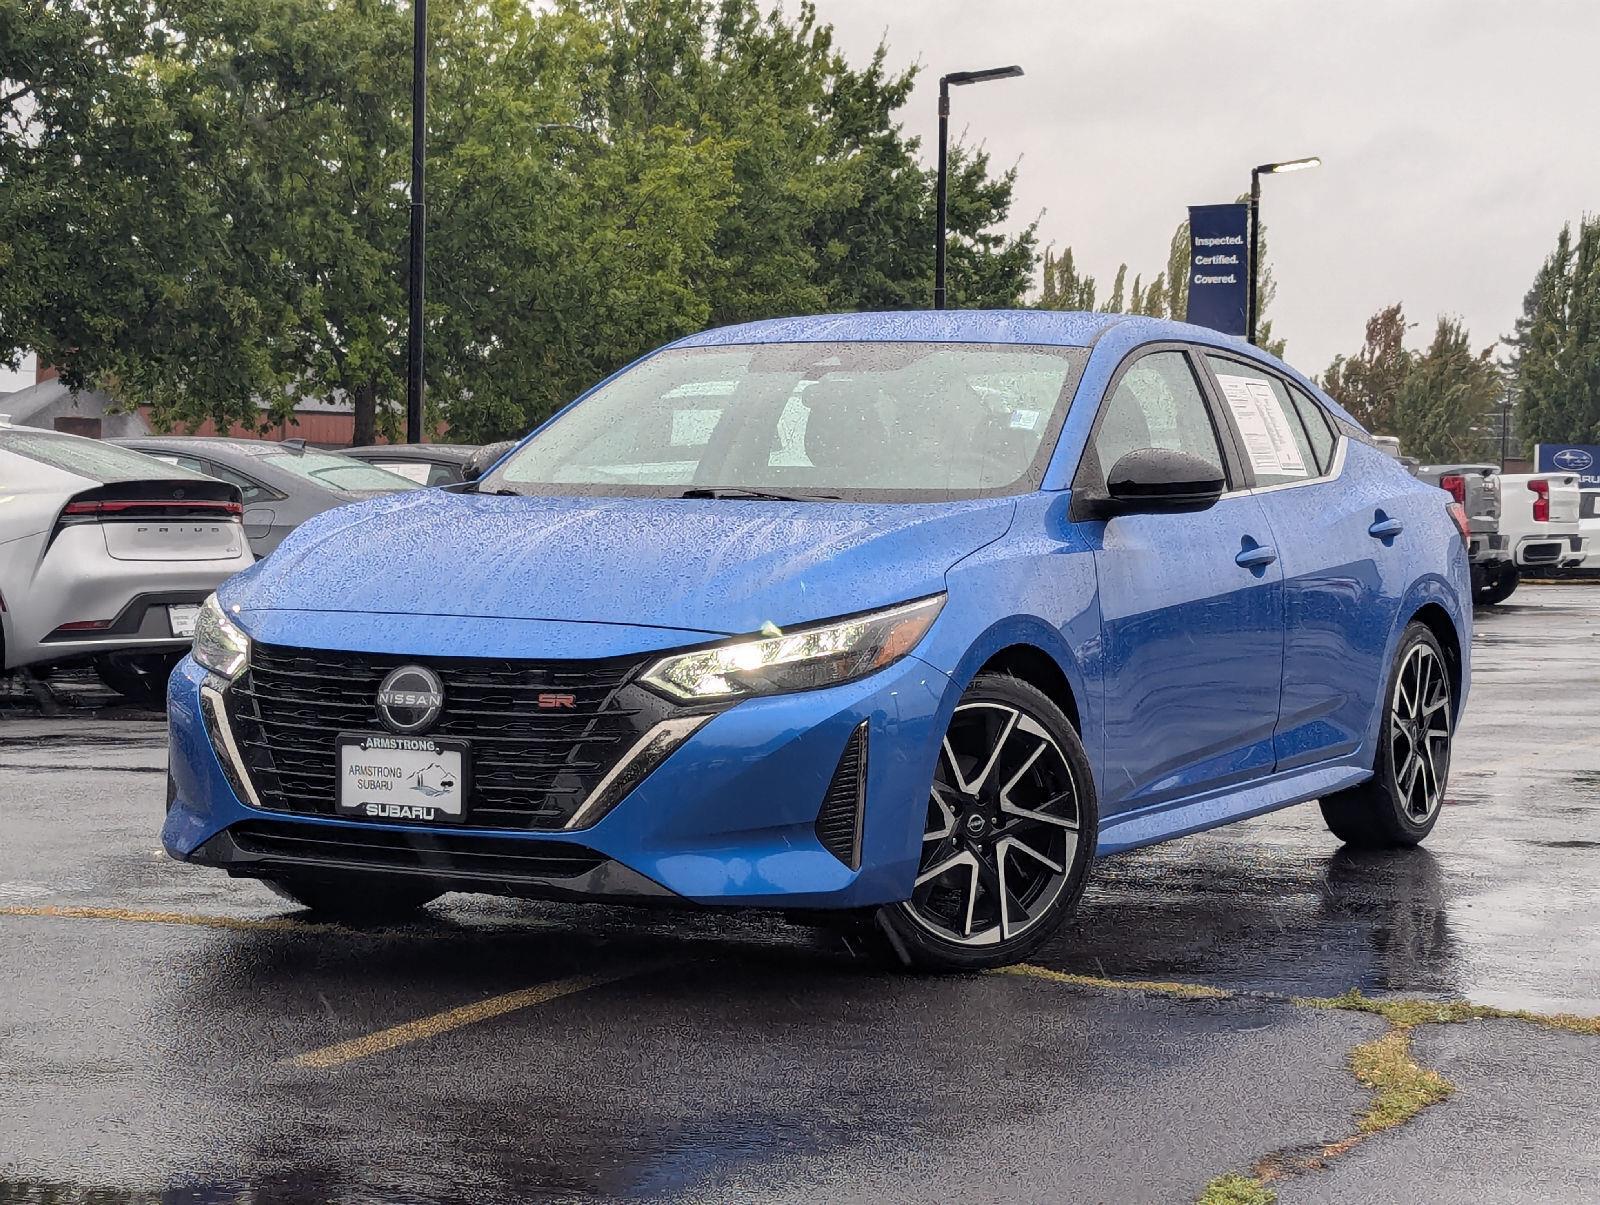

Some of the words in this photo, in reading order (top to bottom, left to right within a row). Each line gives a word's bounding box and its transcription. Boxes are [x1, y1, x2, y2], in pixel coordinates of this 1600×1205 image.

[1195, 235, 1244, 248] Inspected.
[1195, 255, 1239, 265] Certified.
[1194, 274, 1237, 284] Covered.
[379, 693, 440, 706] NISSAN
[538, 694, 577, 707] SR
[366, 737, 435, 751] ARMSTRONG
[348, 765, 402, 778] ARMSTRONG
[357, 779, 393, 791] SUBARU
[366, 803, 435, 820] SUBARU
